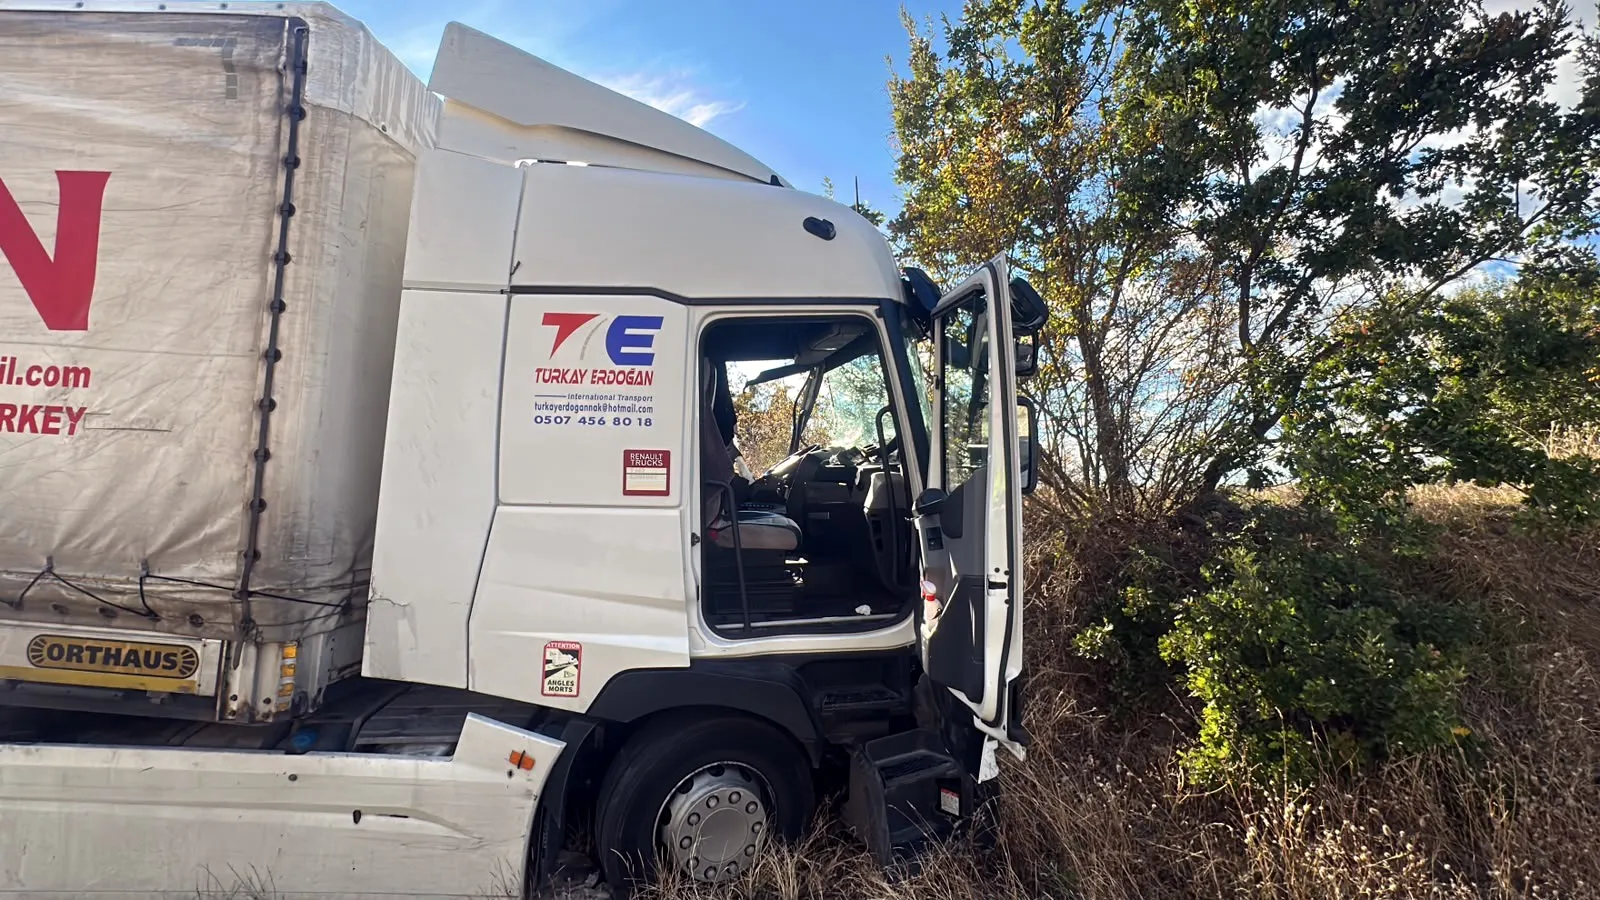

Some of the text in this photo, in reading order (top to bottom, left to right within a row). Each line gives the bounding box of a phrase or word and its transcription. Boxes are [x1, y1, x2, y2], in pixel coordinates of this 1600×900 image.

[591, 369, 653, 385] ERDOĞAN
[567, 393, 653, 402] International Transport
[534, 415, 653, 427] 0507 456 80 18
[46, 642, 179, 671] ORTHAUS
